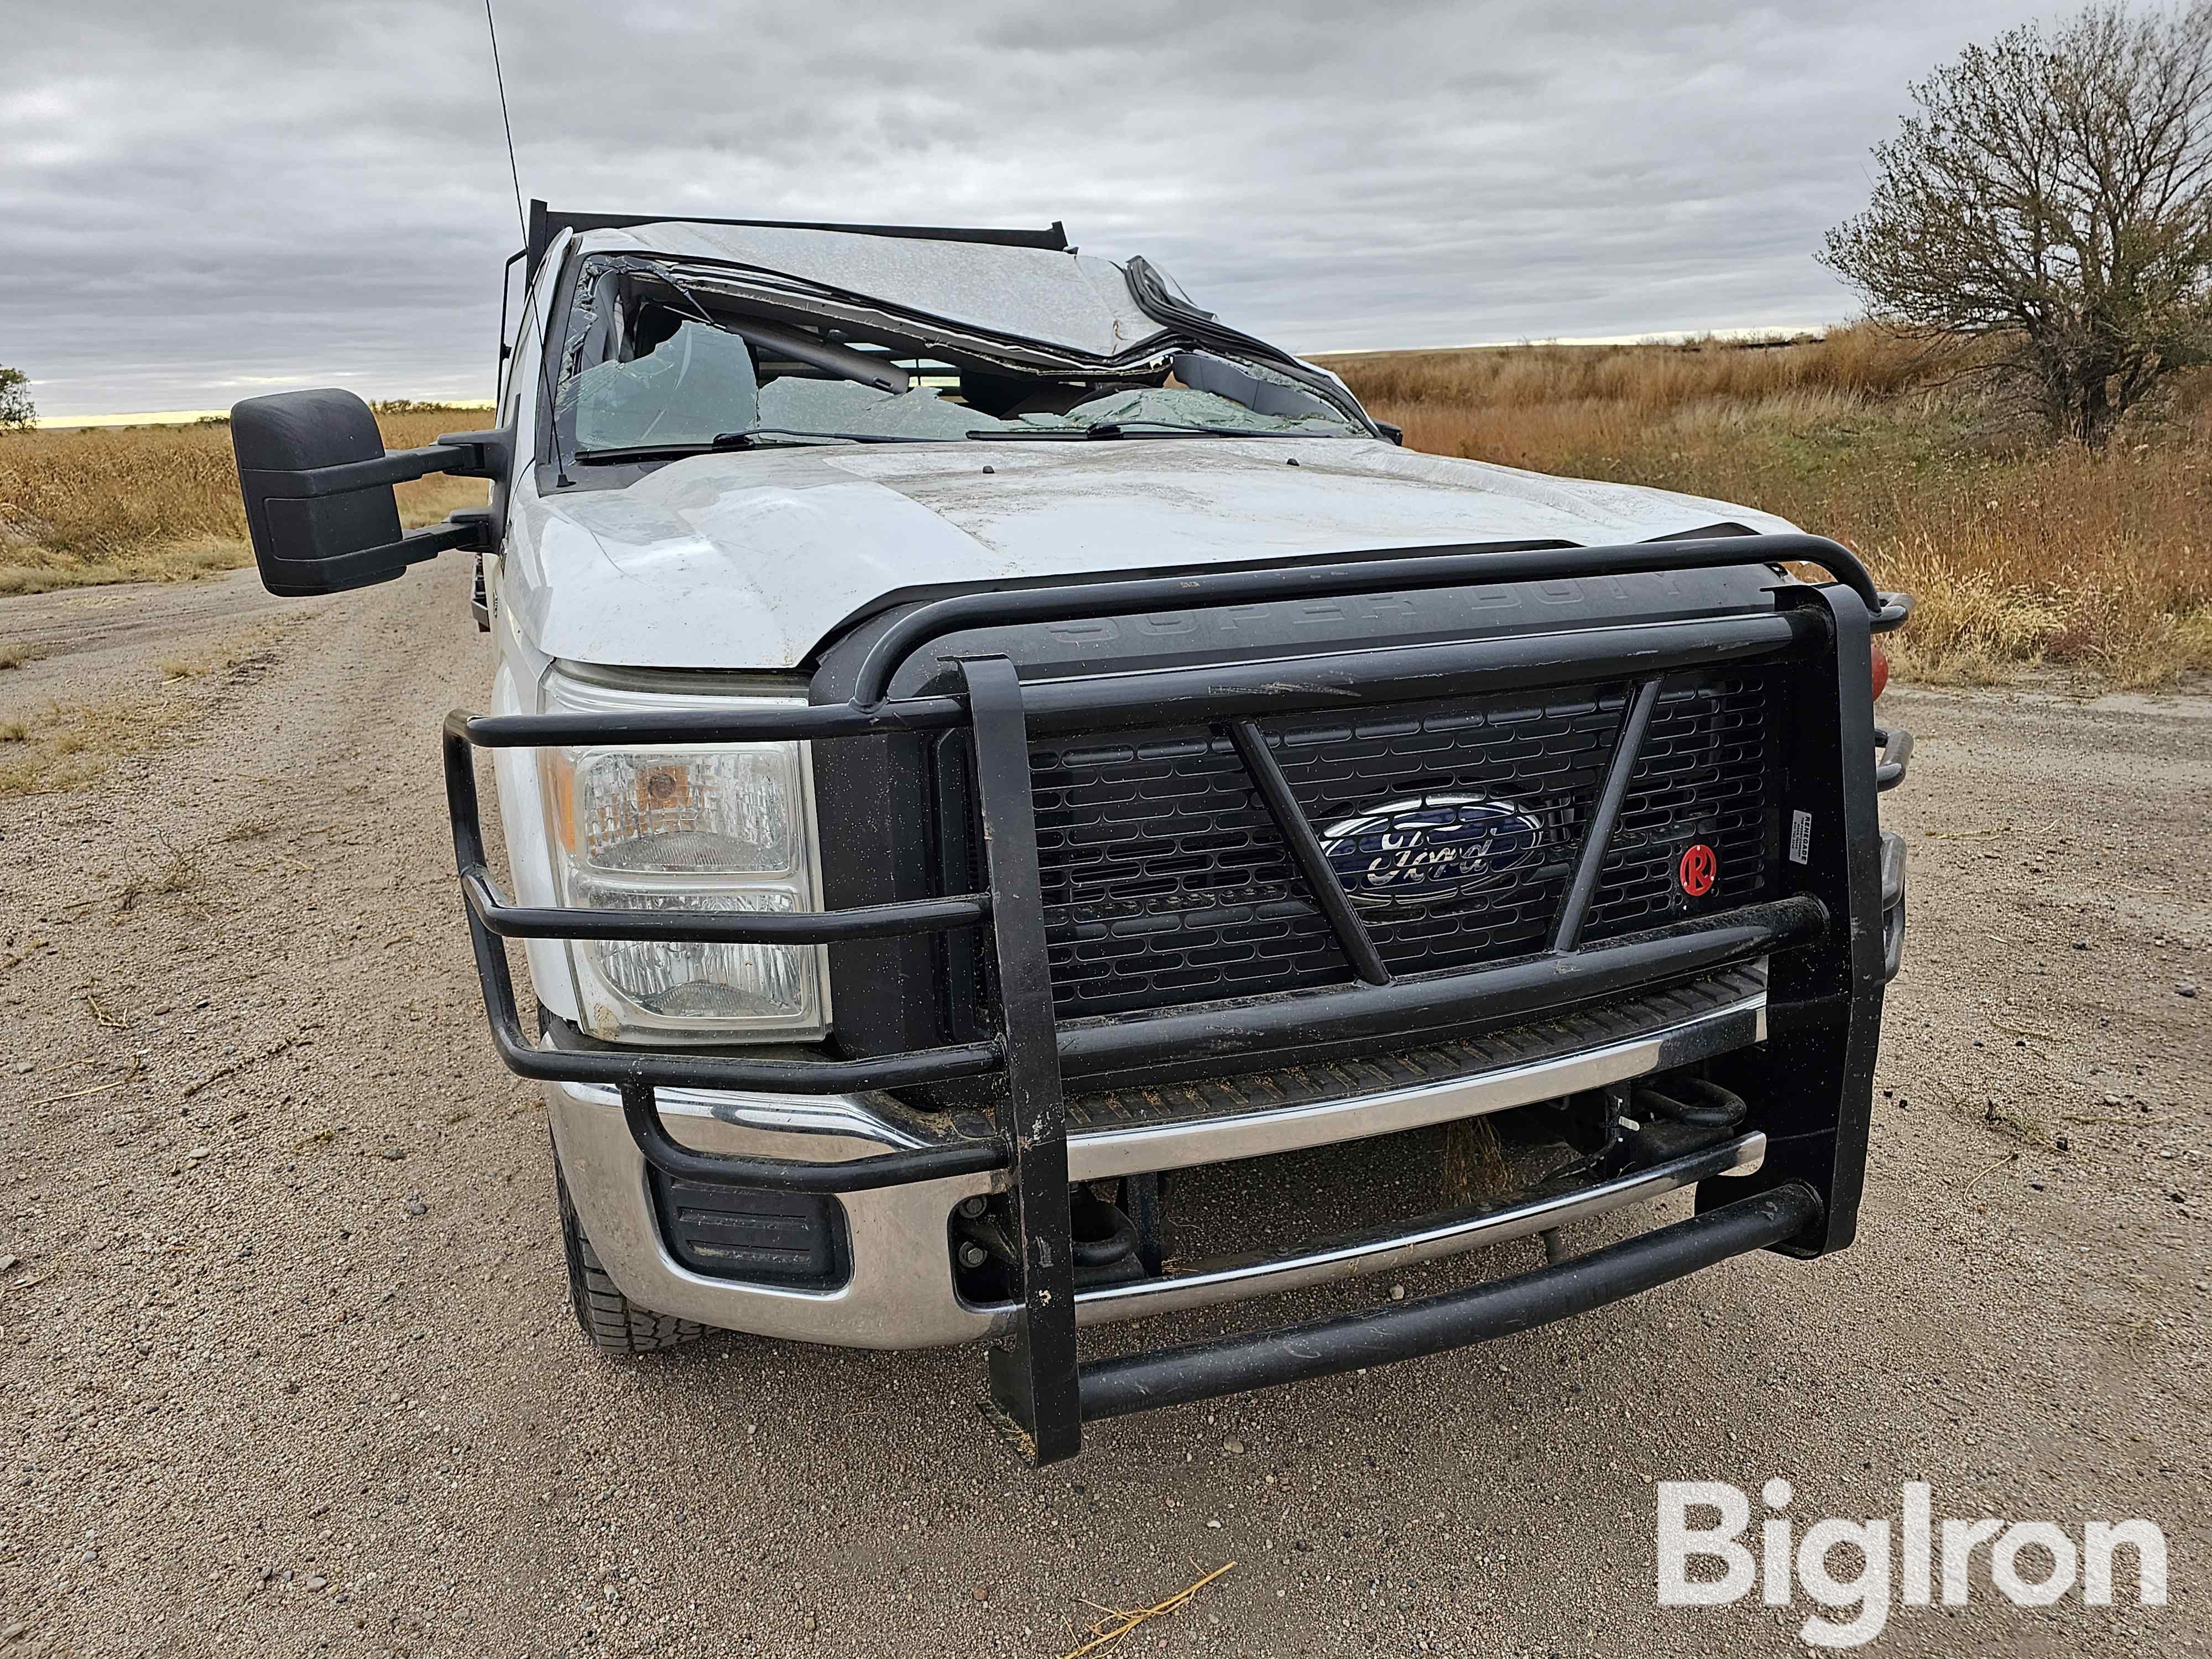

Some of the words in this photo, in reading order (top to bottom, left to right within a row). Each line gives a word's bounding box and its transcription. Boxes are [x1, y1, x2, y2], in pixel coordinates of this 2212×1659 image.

[1049, 594, 1419, 643] SUPER
[1367, 821, 1497, 885] Ford
[1801, 816, 1810, 861] RENEGADE
